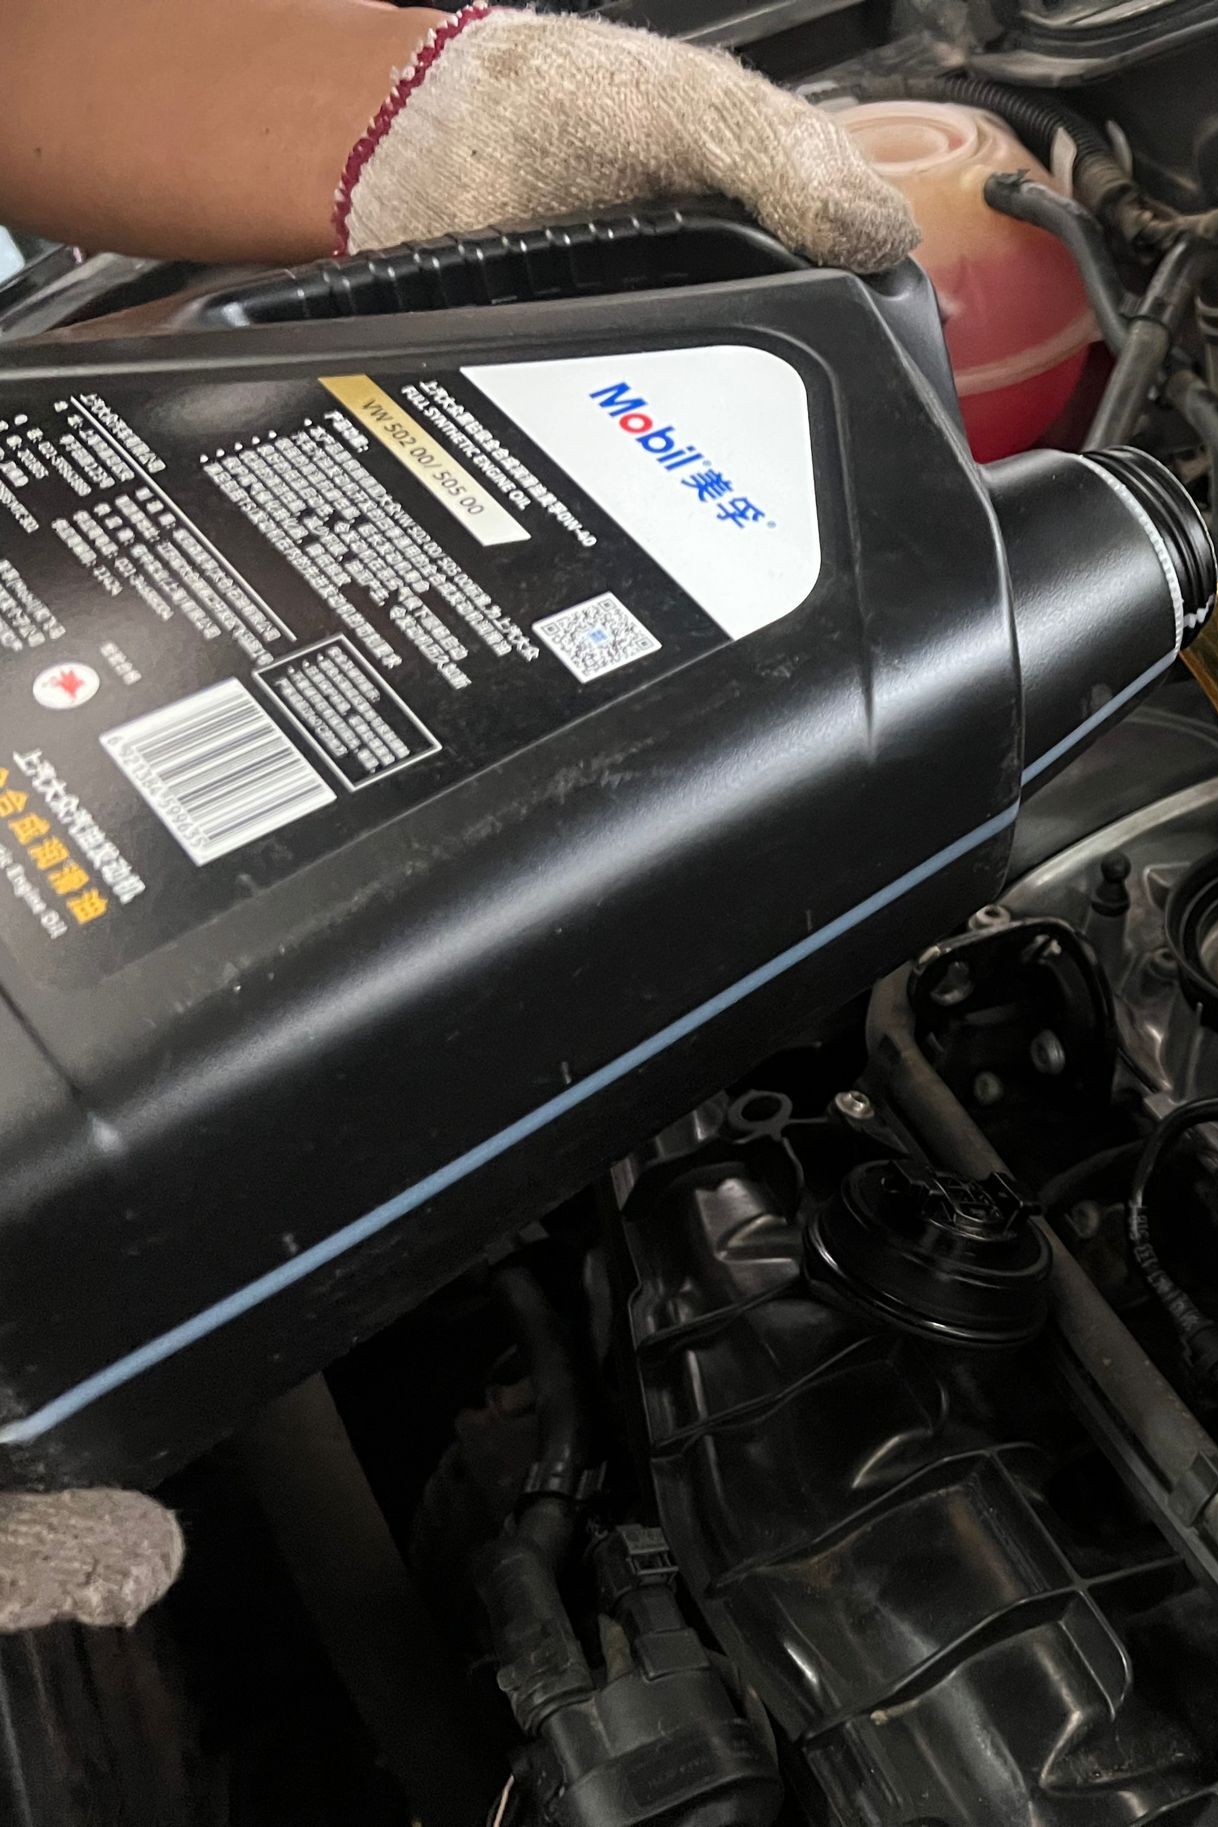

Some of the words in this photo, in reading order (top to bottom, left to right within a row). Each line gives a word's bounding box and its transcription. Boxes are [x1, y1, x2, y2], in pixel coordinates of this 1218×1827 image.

[361, 397, 394, 429] VW
[384, 423, 412, 448] 502
[433, 470, 463, 497] 505
[460, 497, 484, 516] 00
[401, 385, 426, 412] FULL
[425, 406, 480, 459] SYNTHETIC
[473, 452, 516, 494] ENGINE
[509, 489, 531, 511] OIL
[589, 381, 703, 471] Mobil
[681, 468, 765, 529] 美孚
